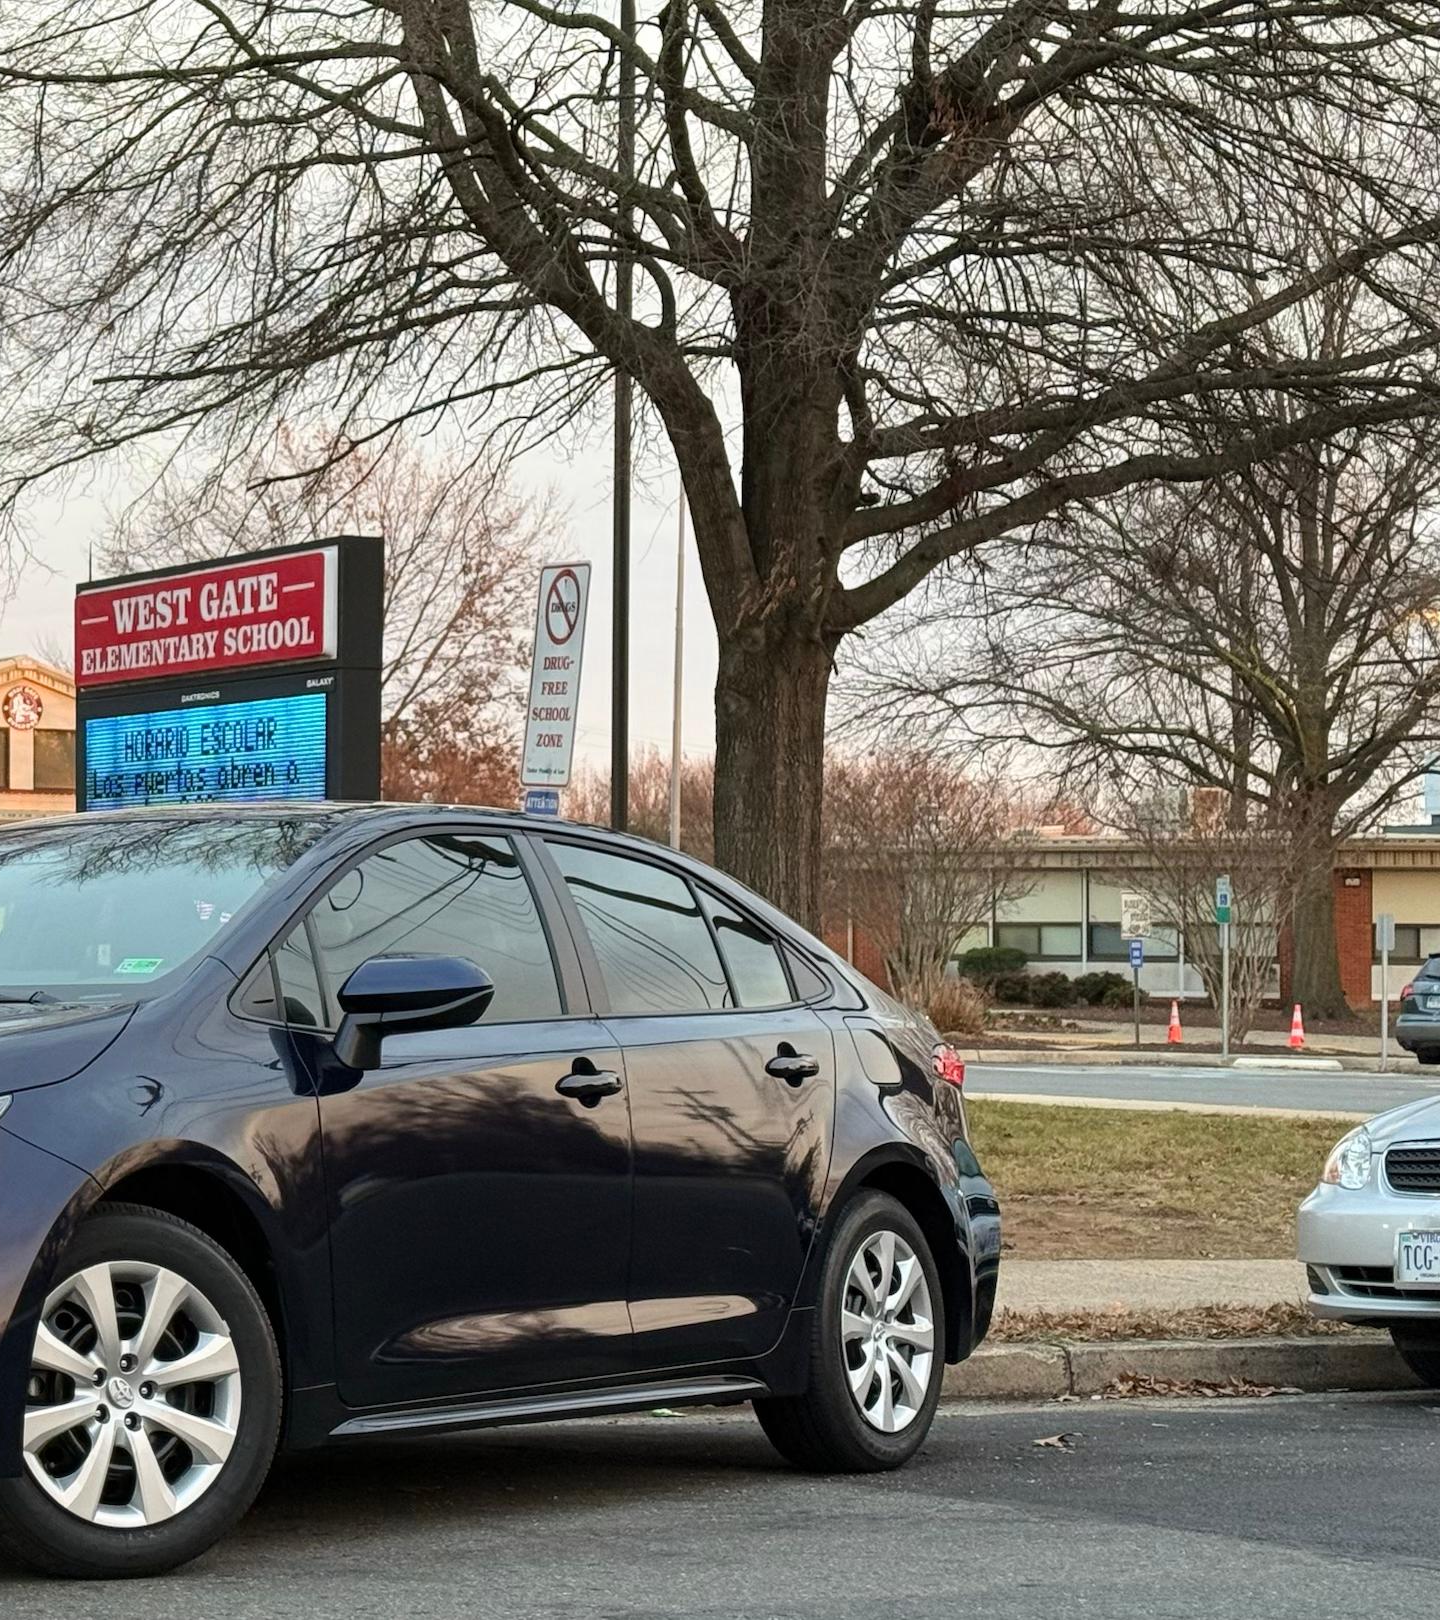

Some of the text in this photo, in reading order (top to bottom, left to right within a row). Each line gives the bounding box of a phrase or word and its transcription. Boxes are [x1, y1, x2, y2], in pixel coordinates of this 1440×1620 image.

[112, 572, 279, 635] WEST GATE
[80, 616, 314, 676] ELEMENTARY SCHOOL
[543, 656, 575, 671] DRUG-
[541, 681, 568, 695] FREE
[532, 707, 571, 721] SCHOOL
[124, 716, 278, 762] HORARIO ESCOLAR
[536, 733, 563, 748] ZONE
